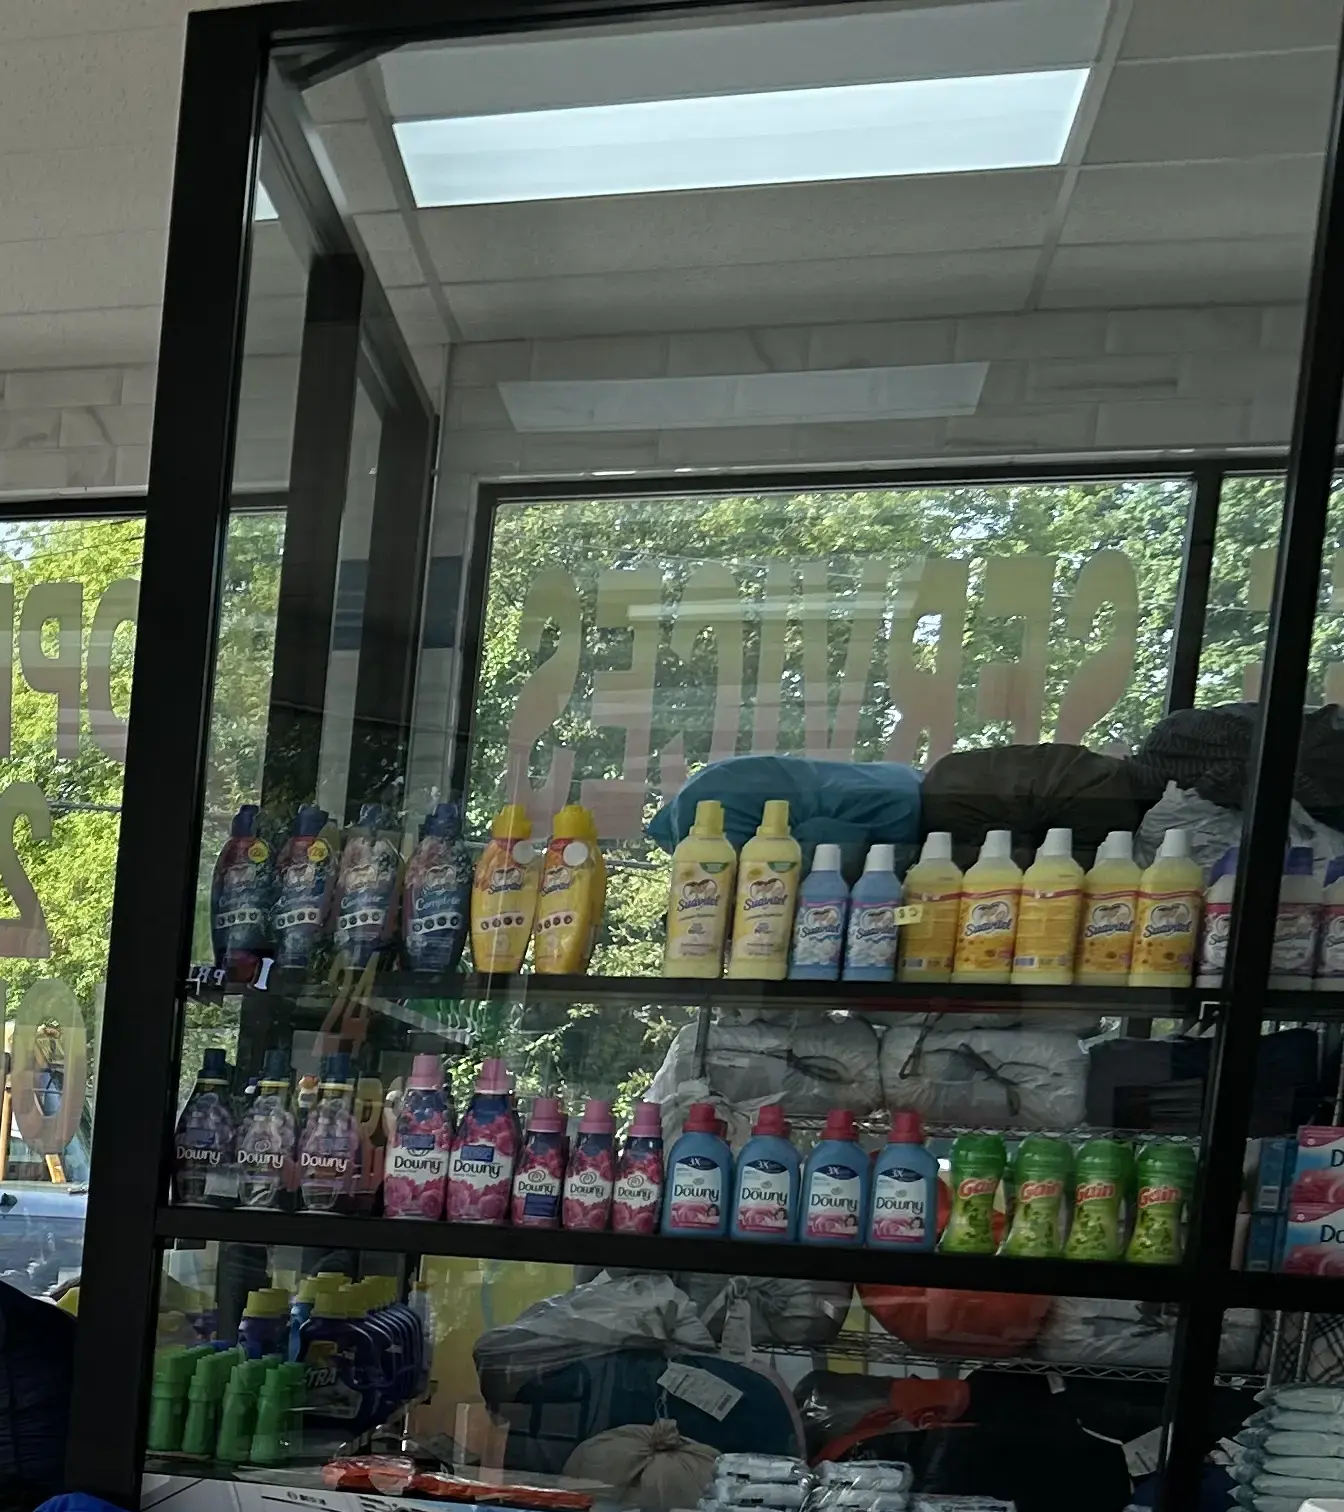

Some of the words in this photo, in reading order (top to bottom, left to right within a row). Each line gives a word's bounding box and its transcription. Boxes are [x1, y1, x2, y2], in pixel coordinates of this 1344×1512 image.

[176, 1146, 224, 1165] Downy
[237, 1149, 285, 1169] Downy
[300, 1153, 349, 1172] Downy
[394, 1155, 442, 1174] Downy
[453, 1159, 503, 1179] Downy
[518, 1180, 558, 1196] Downy
[570, 1183, 605, 1198] Downy
[617, 1187, 653, 1201] Downy
[674, 1184, 719, 1202] Downy
[741, 1186, 788, 1206] Downy
[811, 1192, 857, 1212] Downy
[875, 1196, 924, 1214] Downy
